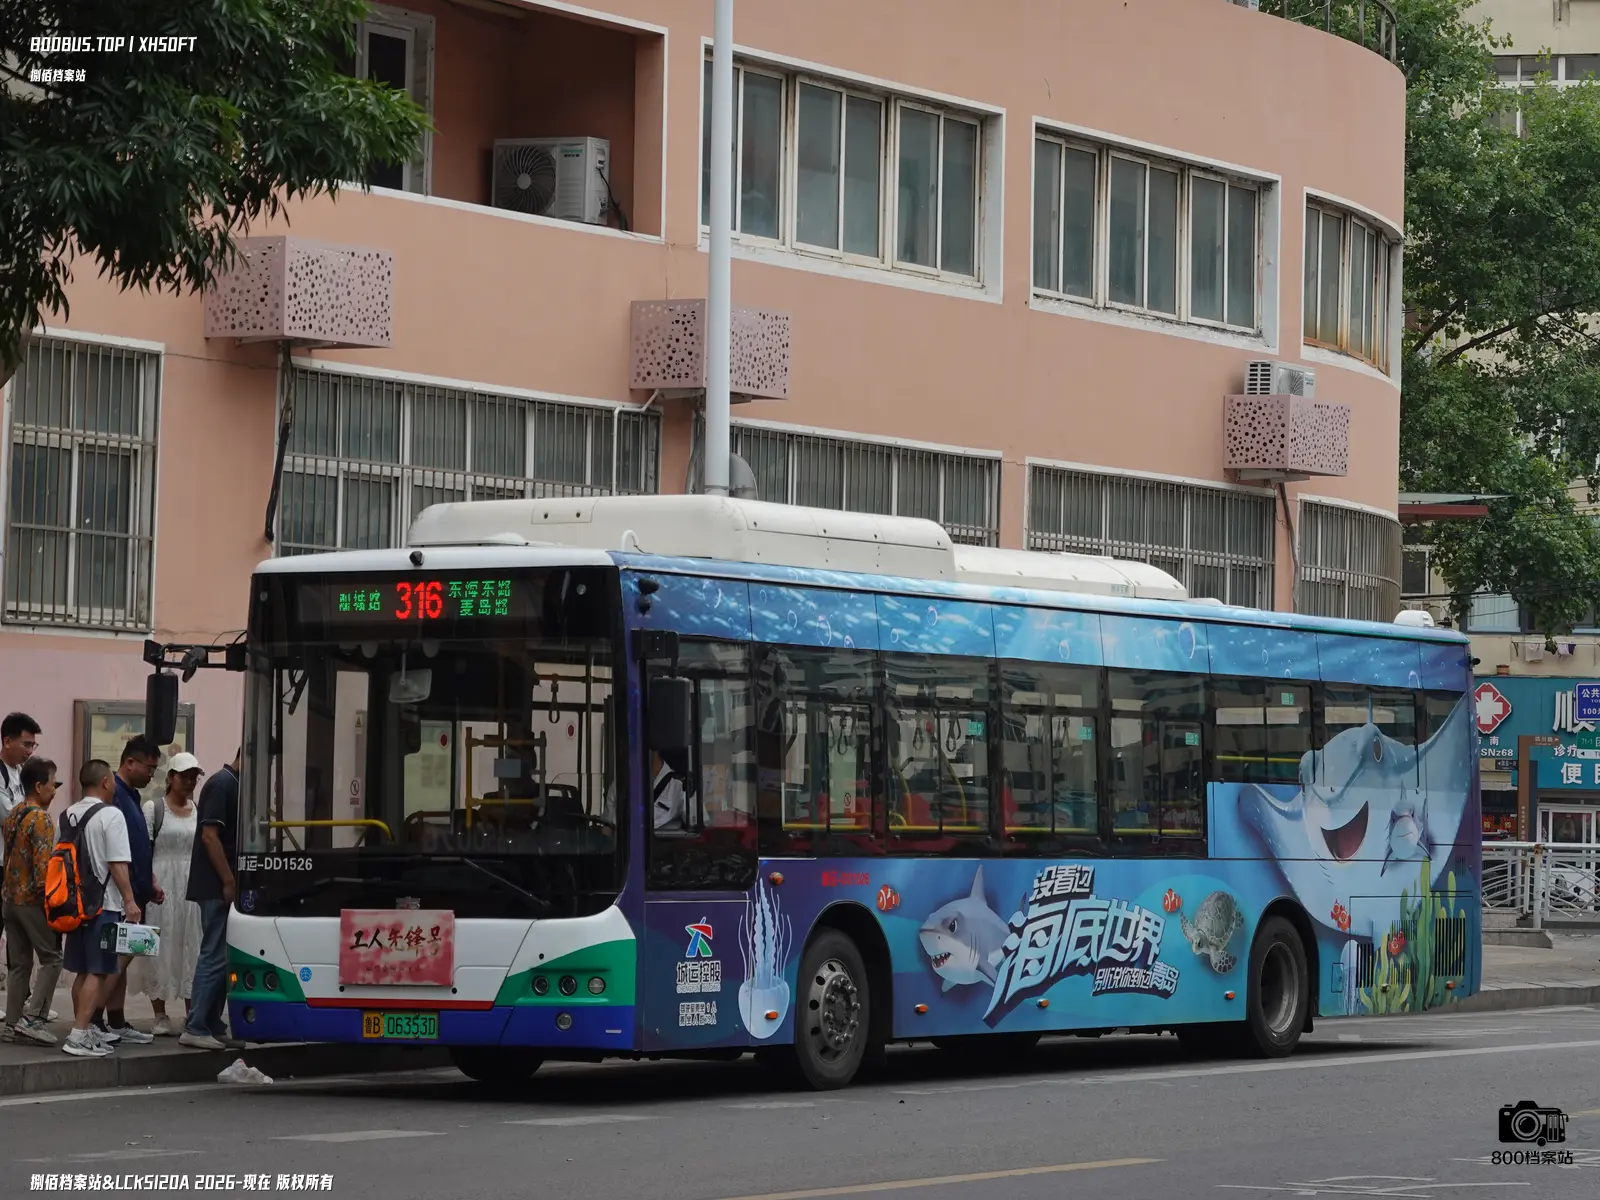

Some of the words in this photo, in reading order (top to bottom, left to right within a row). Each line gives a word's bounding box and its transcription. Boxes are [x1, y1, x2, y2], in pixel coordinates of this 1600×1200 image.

[395, 581, 443, 619] 316
[1480, 748, 1514, 757] SNz68
[1029, 863, 1095, 901] 没看过
[349, 926, 442, 957] 工人先锋号
[982, 894, 1167, 1020] 海底世界
[677, 961, 721, 984] 城运控股
[1091, 960, 1181, 994] 别说你到过青岛
[365, 1017, 380, 1034] 鲁B
[387, 1017, 436, 1035] 06353D
